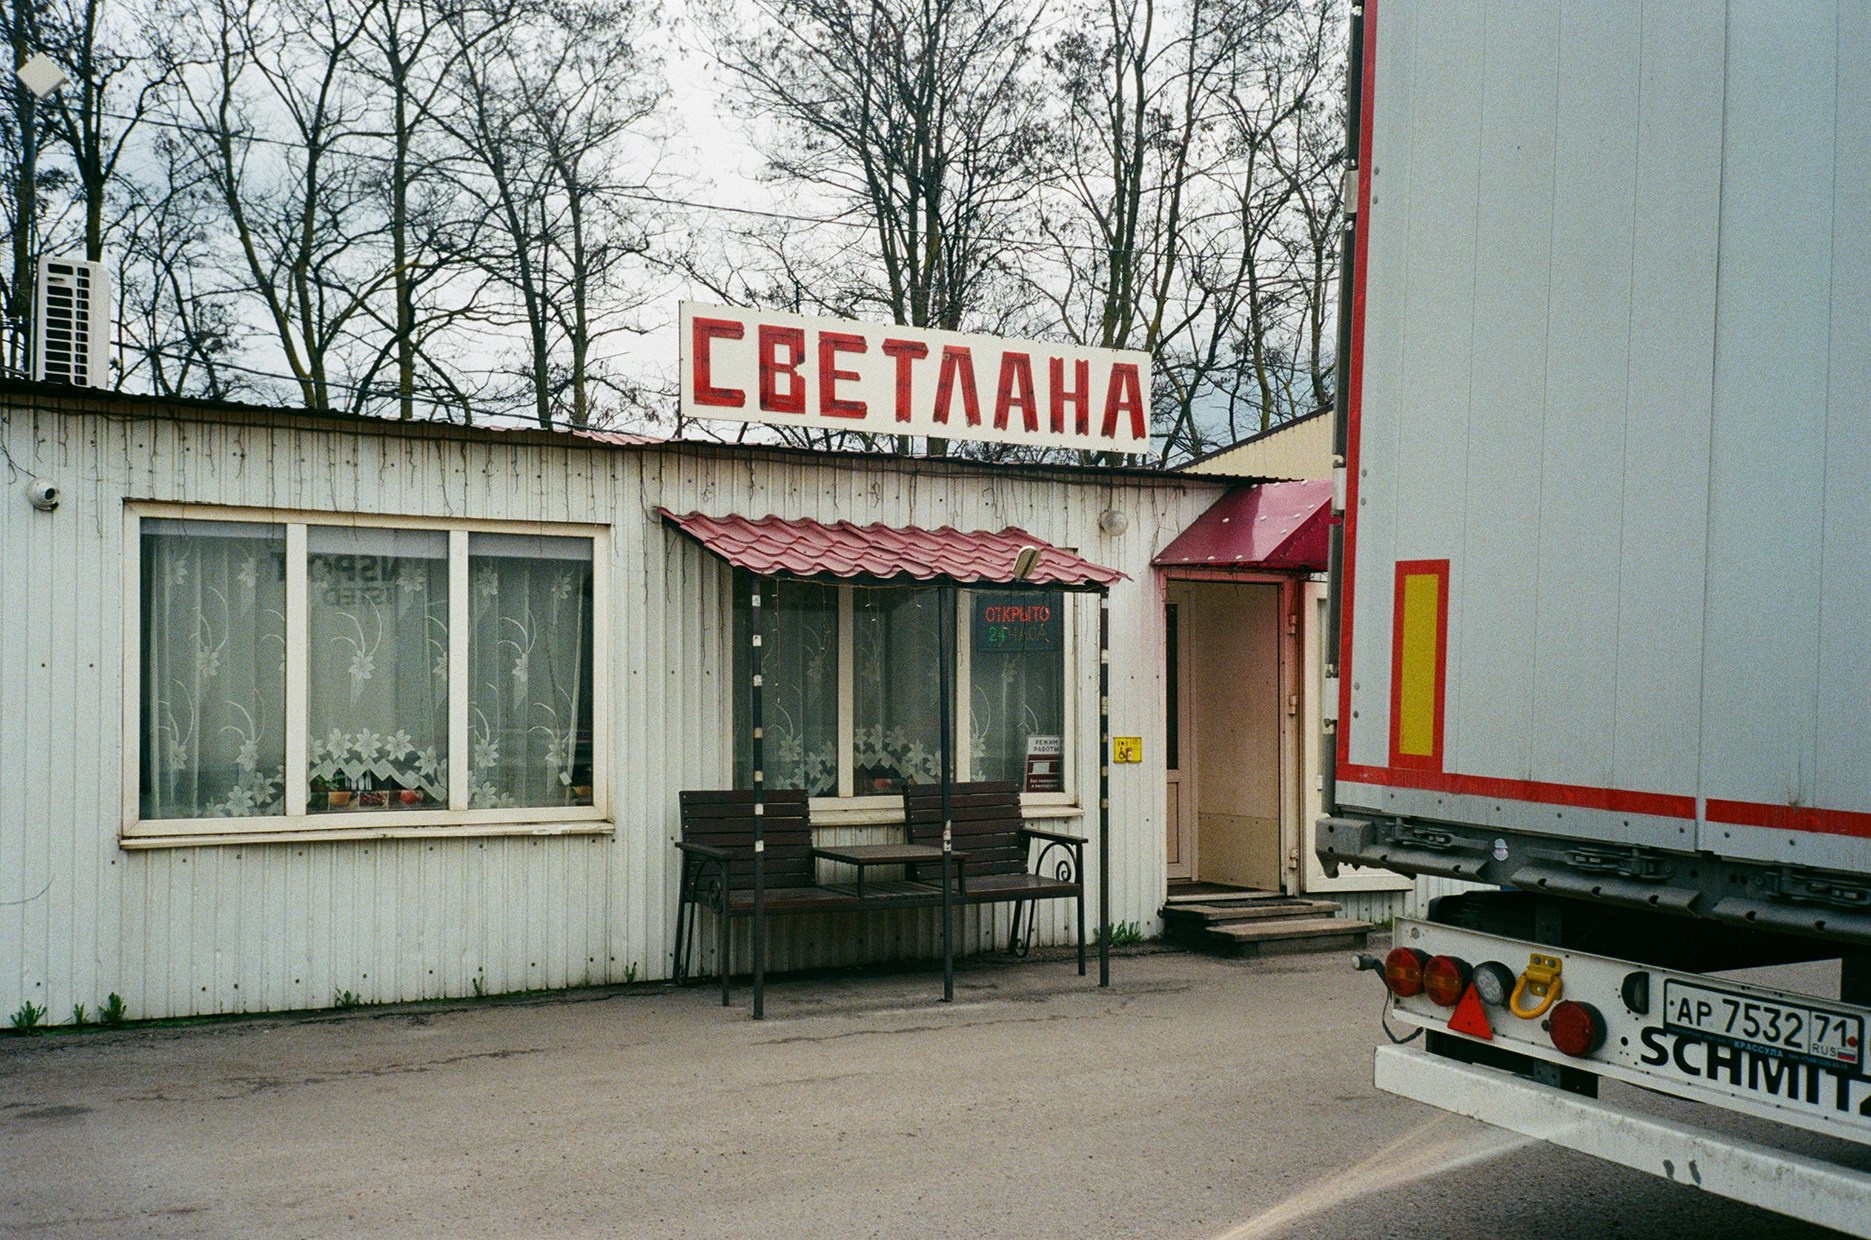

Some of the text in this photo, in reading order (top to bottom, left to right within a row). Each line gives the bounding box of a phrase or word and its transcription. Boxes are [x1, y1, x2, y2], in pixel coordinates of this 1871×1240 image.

[692, 316, 1147, 440] СВЕТЛАНА
[985, 605, 1051, 622] ОТКРЫТО
[989, 626, 1007, 641] 24
[1722, 998, 1803, 1049] 7532
[1814, 1014, 1847, 1047] 71
[1733, 1039, 1784, 1059] КРАССУЛА
[1812, 1043, 1837, 1058] RUS
